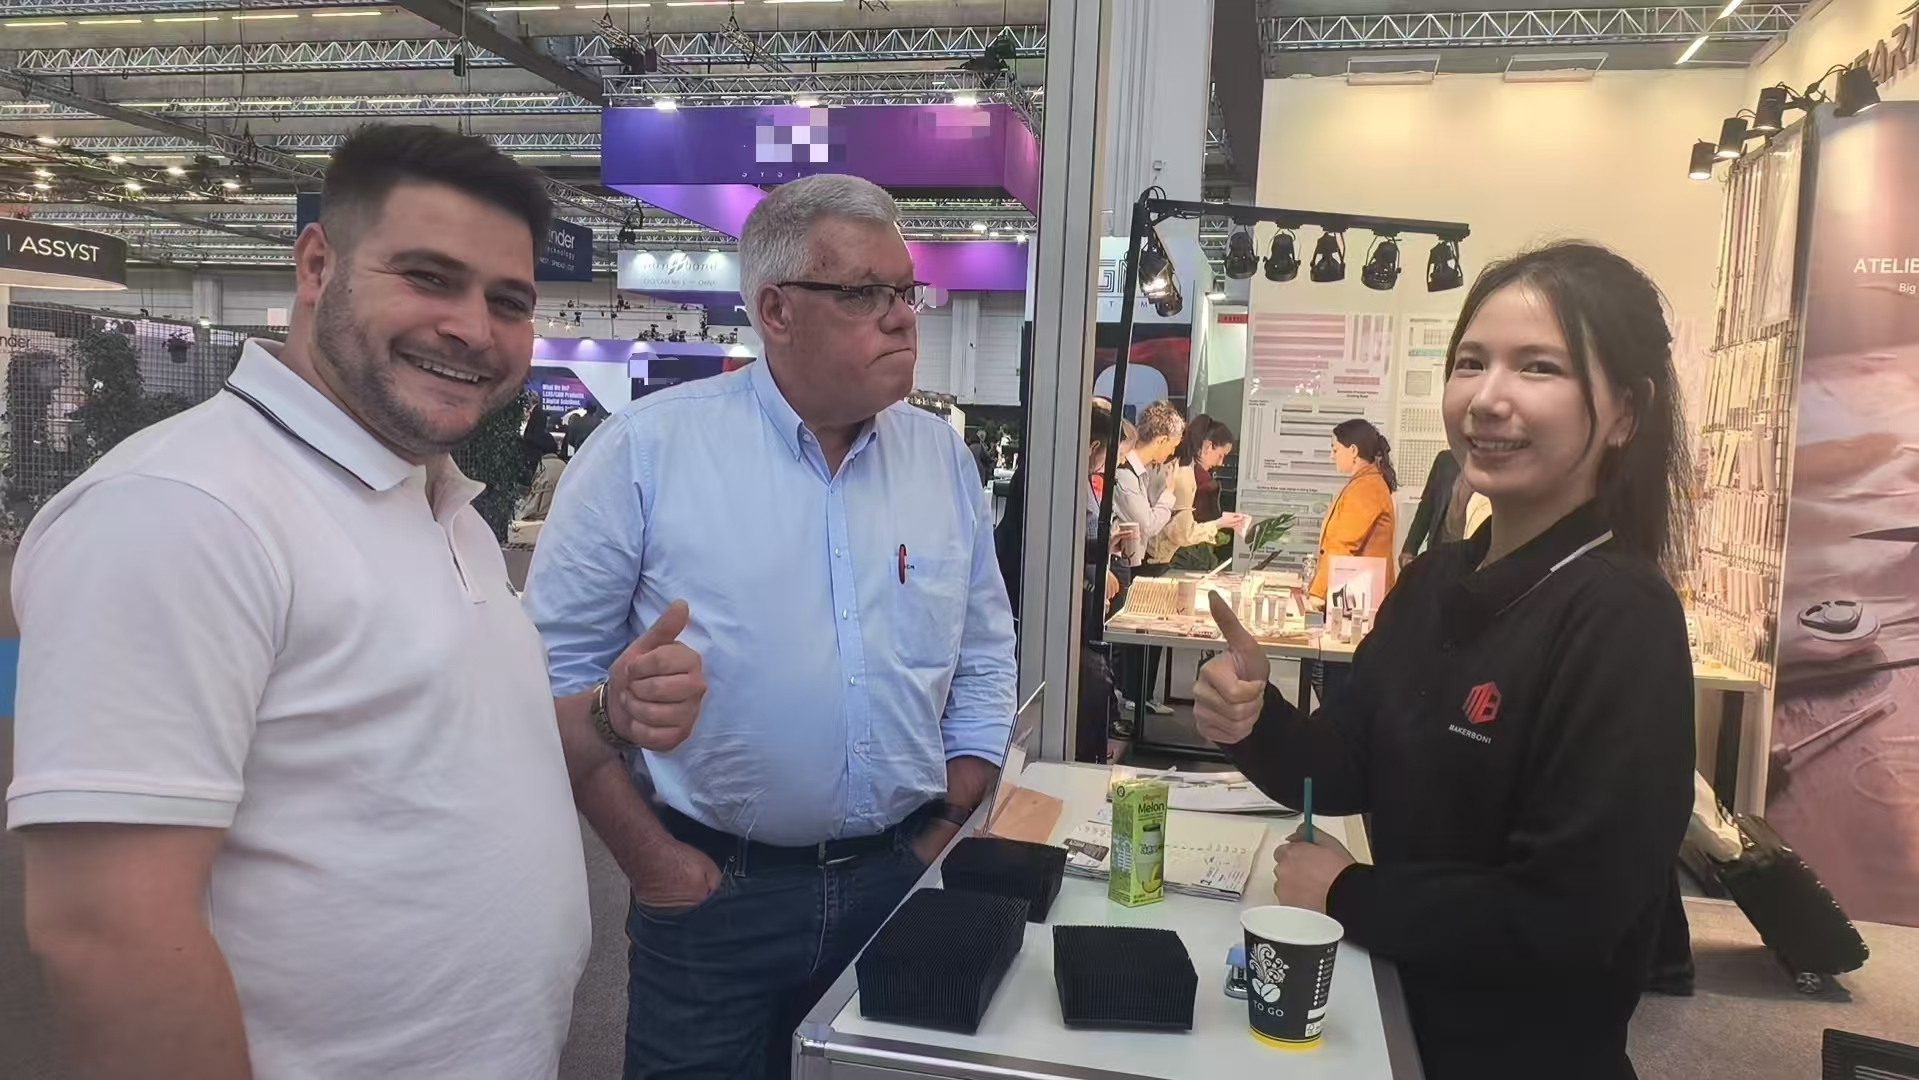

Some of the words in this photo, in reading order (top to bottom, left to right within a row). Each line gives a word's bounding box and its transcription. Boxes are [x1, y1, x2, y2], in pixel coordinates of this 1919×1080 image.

[20, 236, 100, 262] ASSYST
[1899, 282, 1916, 294] Big
[1448, 723, 1492, 744] MAKERBONI
[1138, 803, 1165, 814] Melon
[1254, 1000, 1265, 1012] TO
[1267, 1006, 1284, 1017] GO
